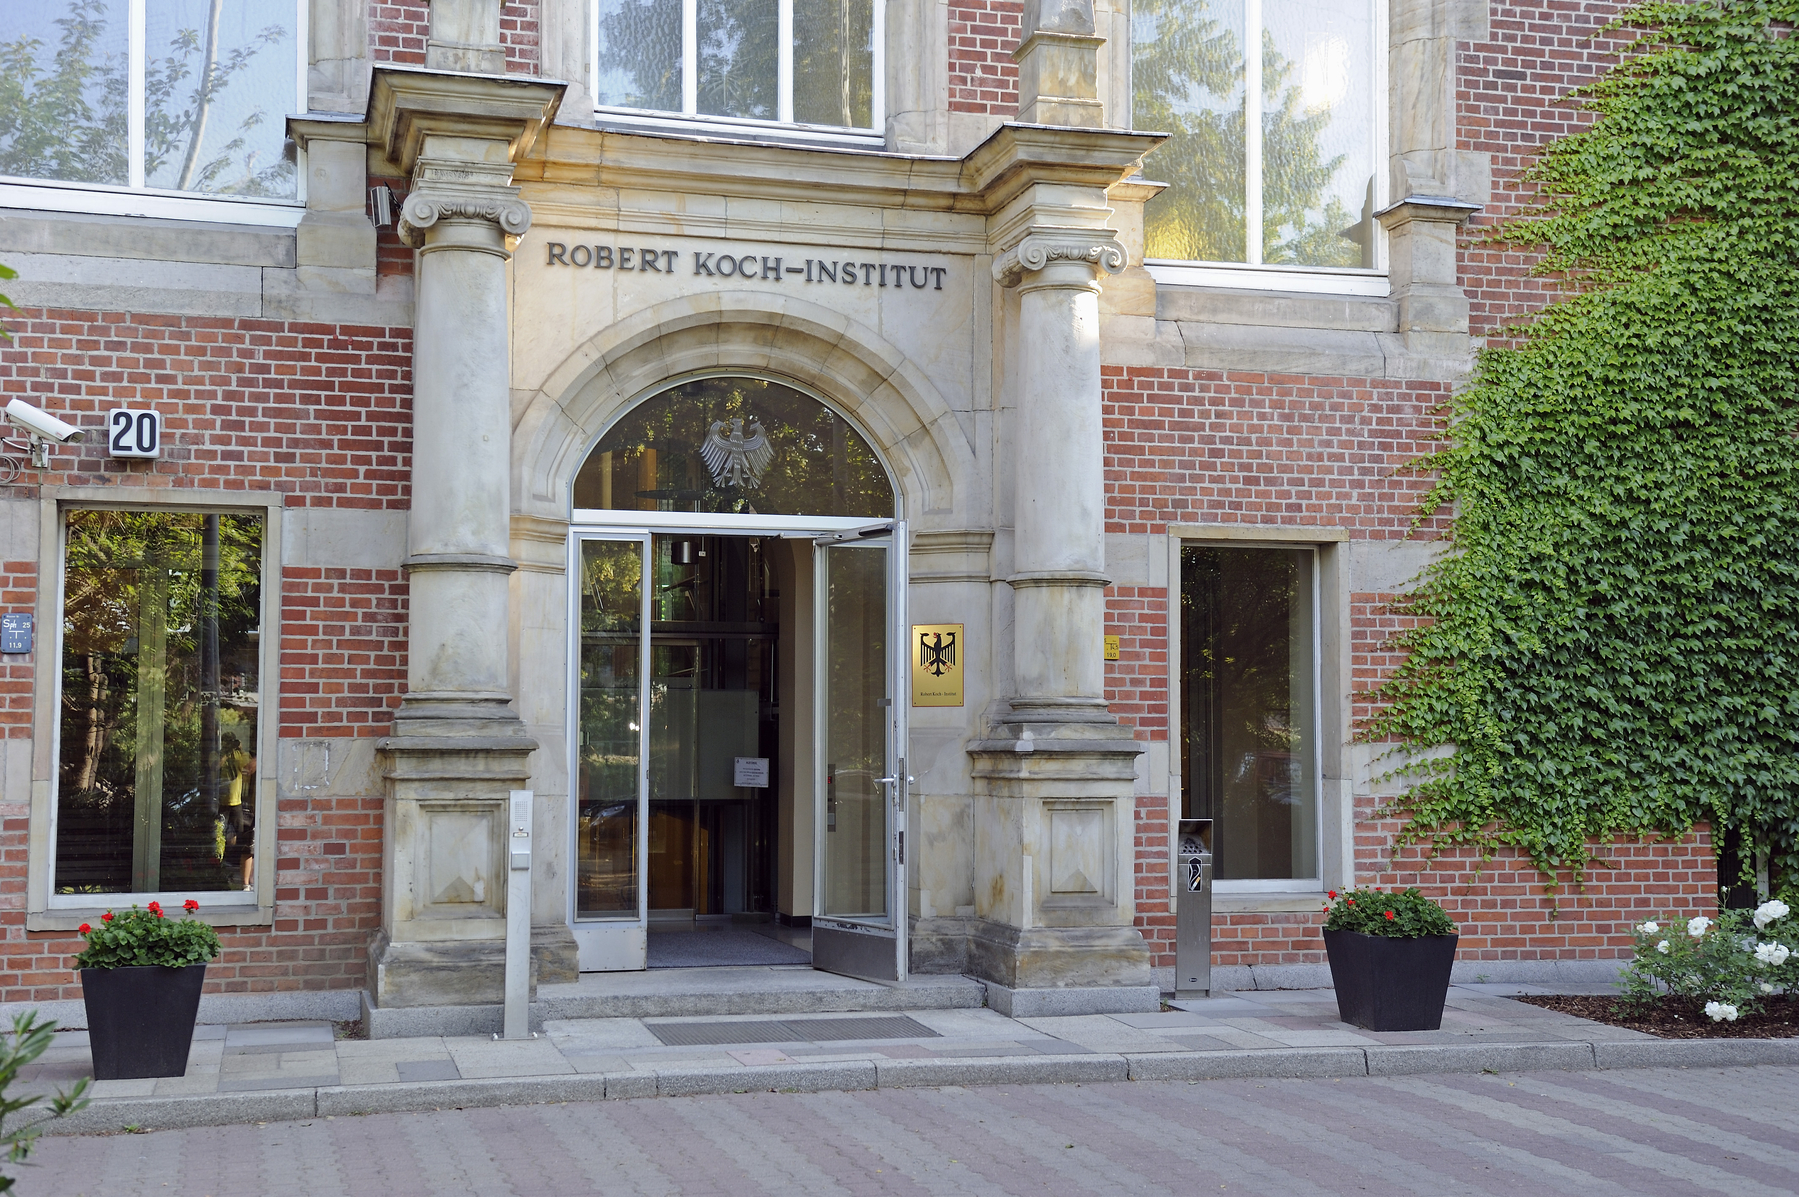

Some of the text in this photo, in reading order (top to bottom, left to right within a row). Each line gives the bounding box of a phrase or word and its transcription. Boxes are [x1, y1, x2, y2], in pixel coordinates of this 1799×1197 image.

[546, 241, 947, 291] ROBERT KOCH-INSTITUT
[112, 411, 157, 453] 20
